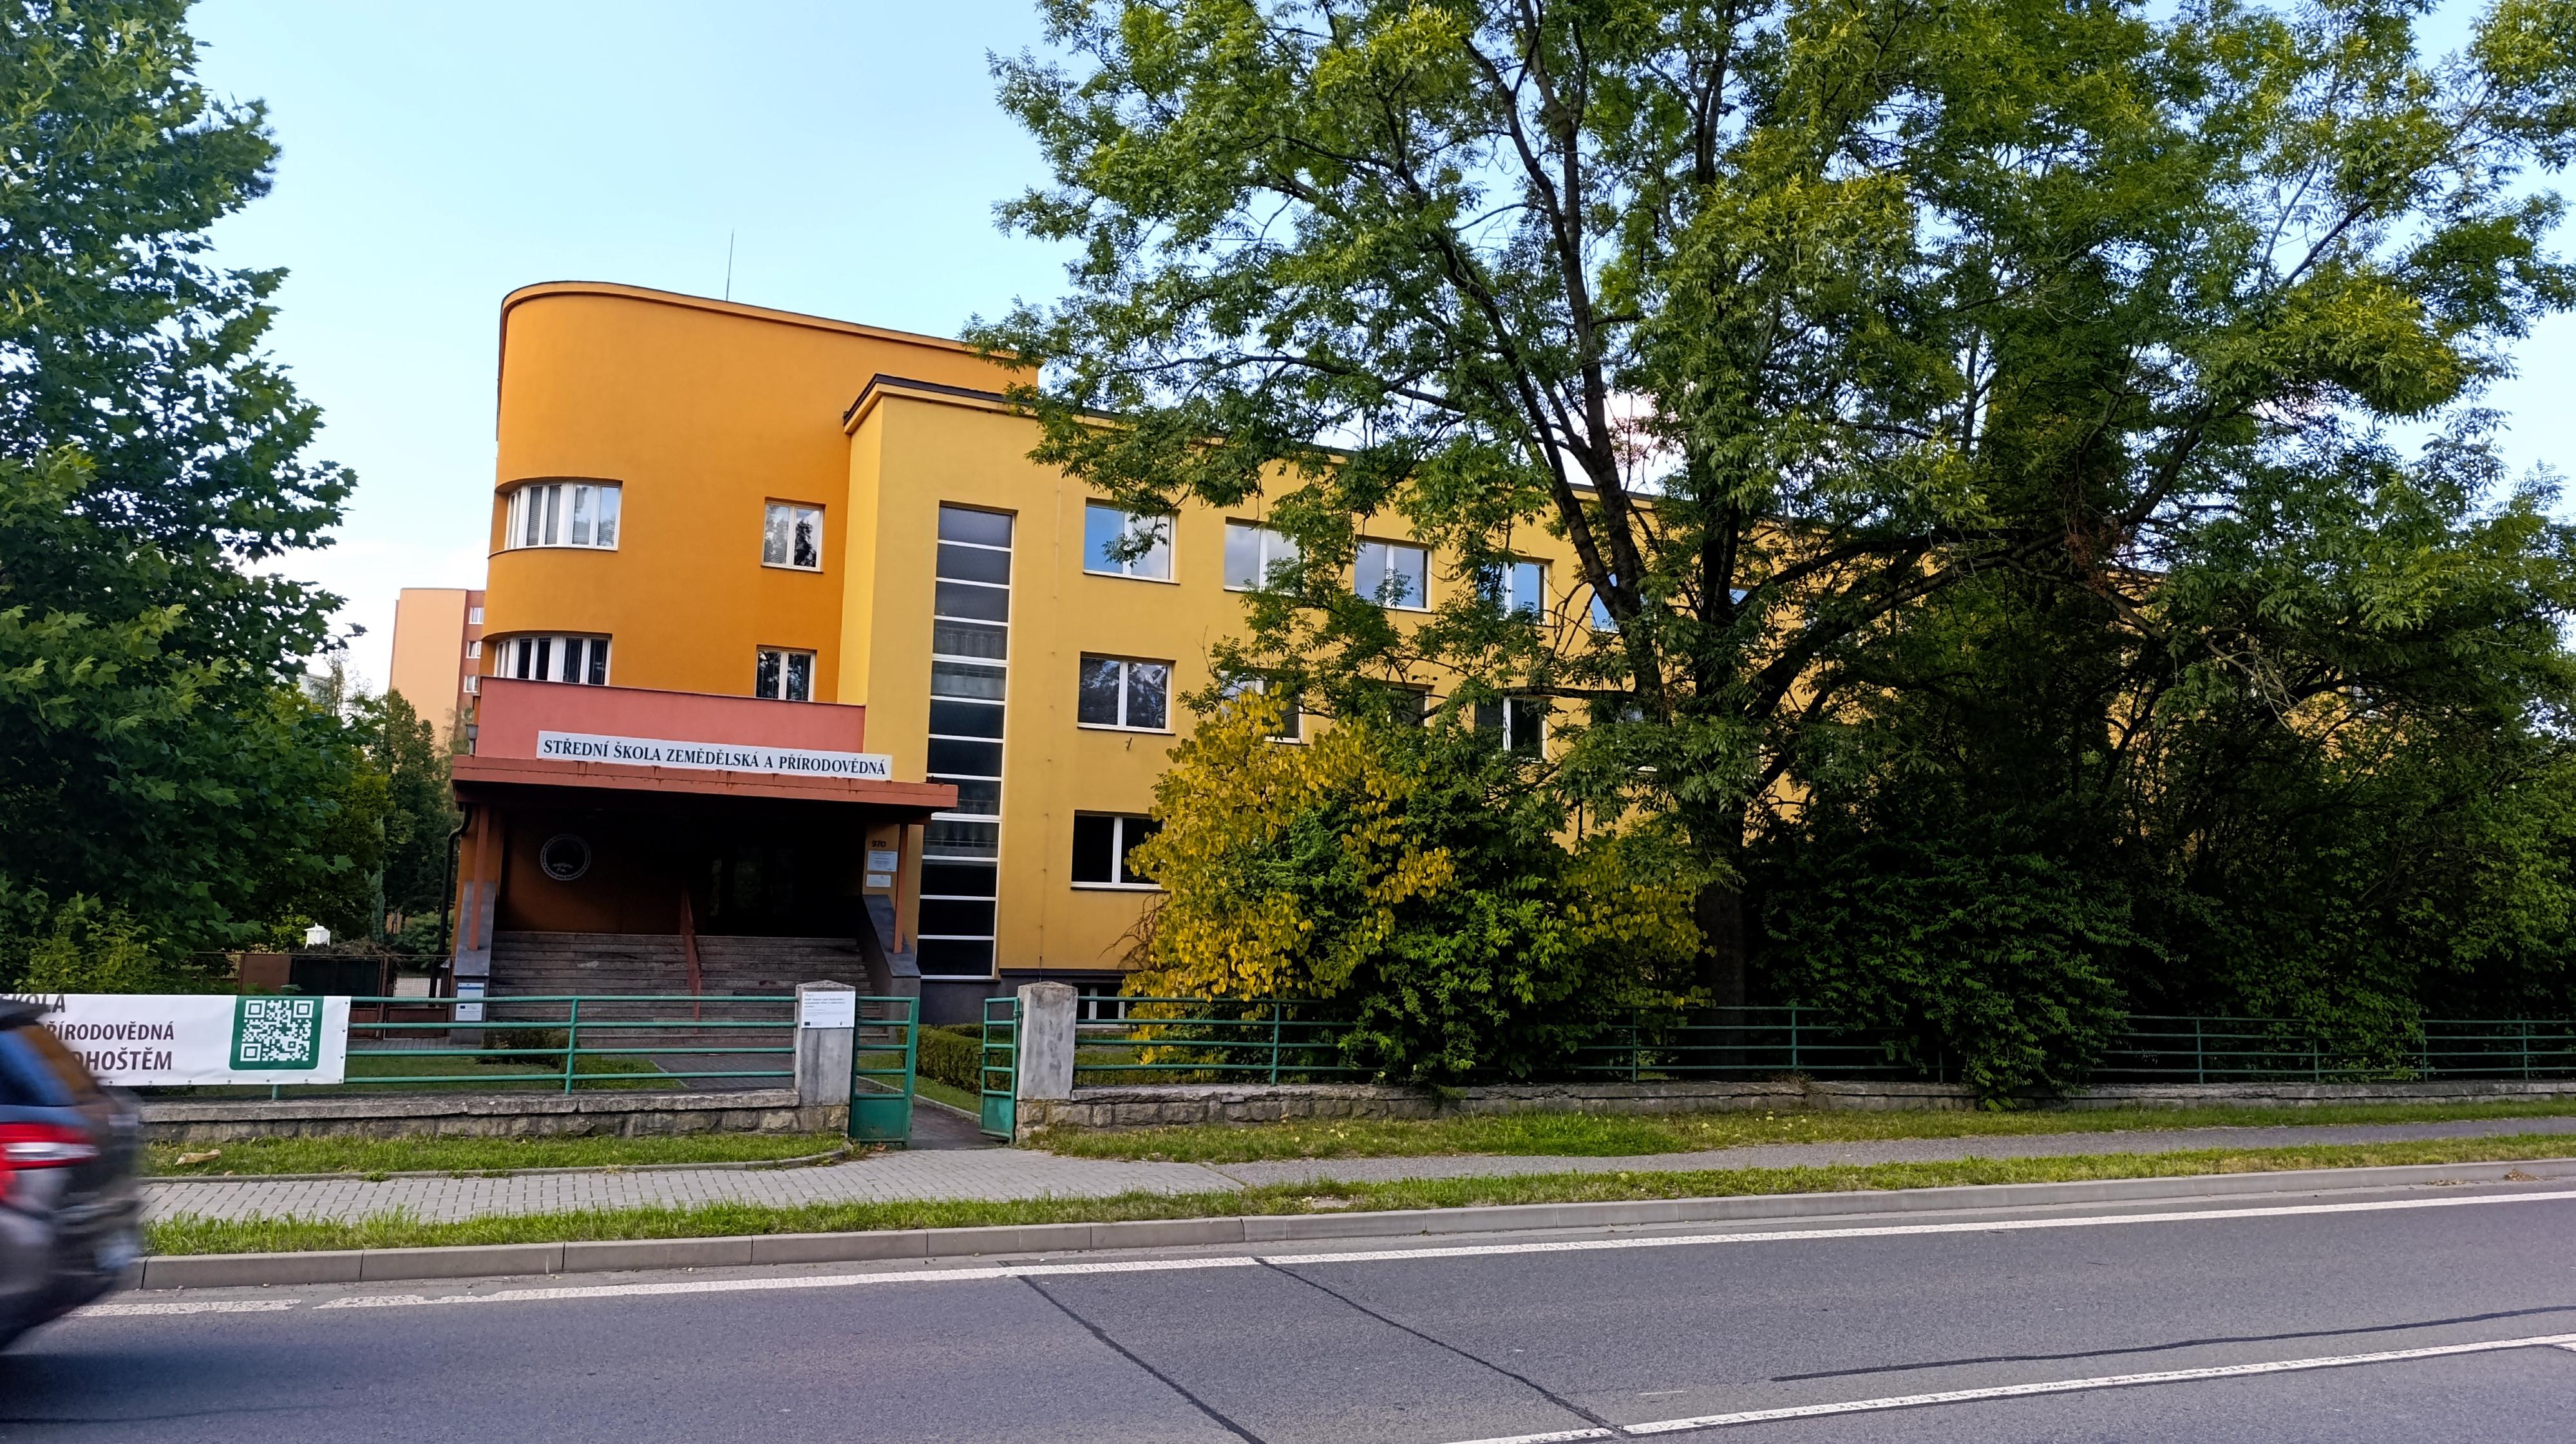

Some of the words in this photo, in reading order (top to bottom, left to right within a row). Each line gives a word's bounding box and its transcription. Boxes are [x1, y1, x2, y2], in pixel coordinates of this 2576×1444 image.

[544, 738, 609, 757] STŘEDNÍ
[614, 742, 661, 761] ŠKOLA
[666, 747, 759, 767] ZEMĚDĚLSKÁ
[764, 756, 773, 768] A
[779, 753, 886, 775] PŘÍRODOVĚDNÁ
[46, 1020, 174, 1040] ŘÍRODOVĚDNÁ
